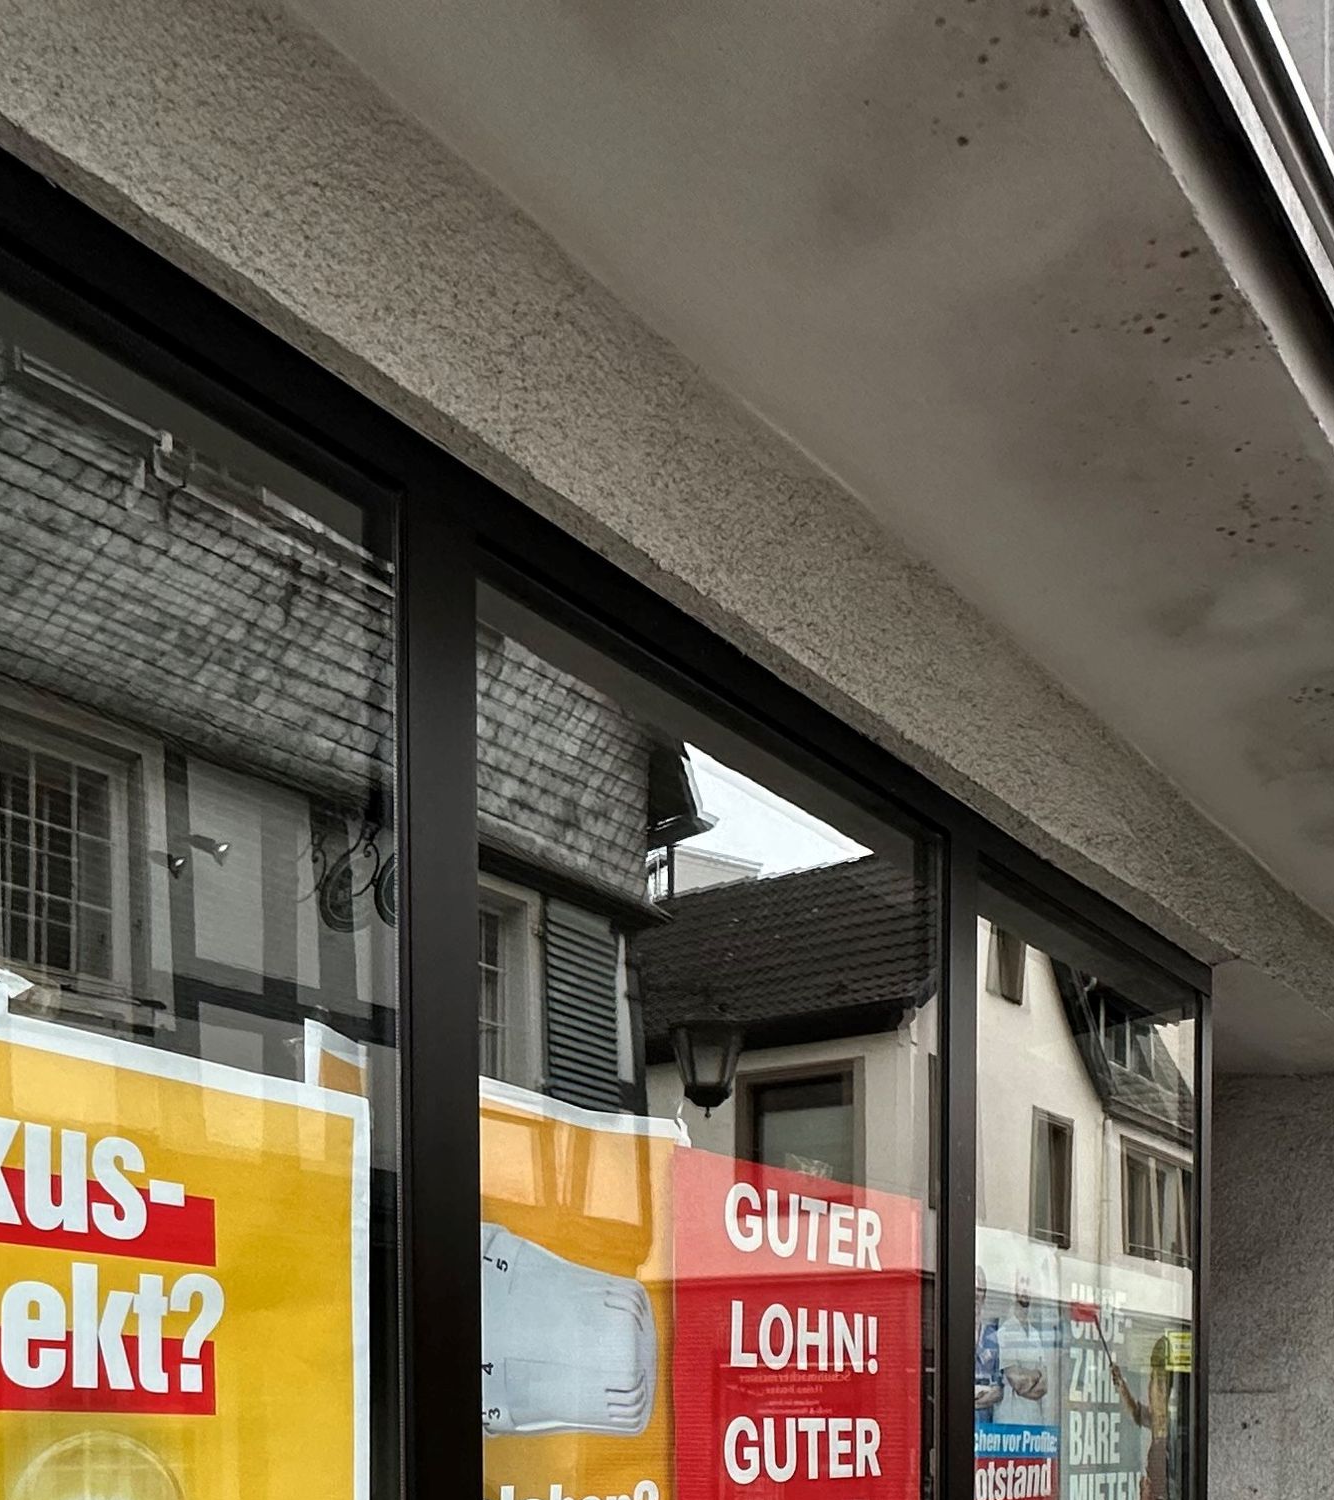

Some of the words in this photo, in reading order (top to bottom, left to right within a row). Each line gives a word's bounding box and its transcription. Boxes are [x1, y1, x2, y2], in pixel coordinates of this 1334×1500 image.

[724, 1181, 882, 1272] GUTER
[496, 1257, 509, 1272] 5
[729, 1300, 879, 1375] LOHN!
[482, 1362, 494, 1376] 4
[488, 1407, 501, 1420] 3
[724, 1416, 882, 1485] GUTER
[1003, 1434, 1022, 1452] vor
[1069, 1410, 1120, 1465] BARE
